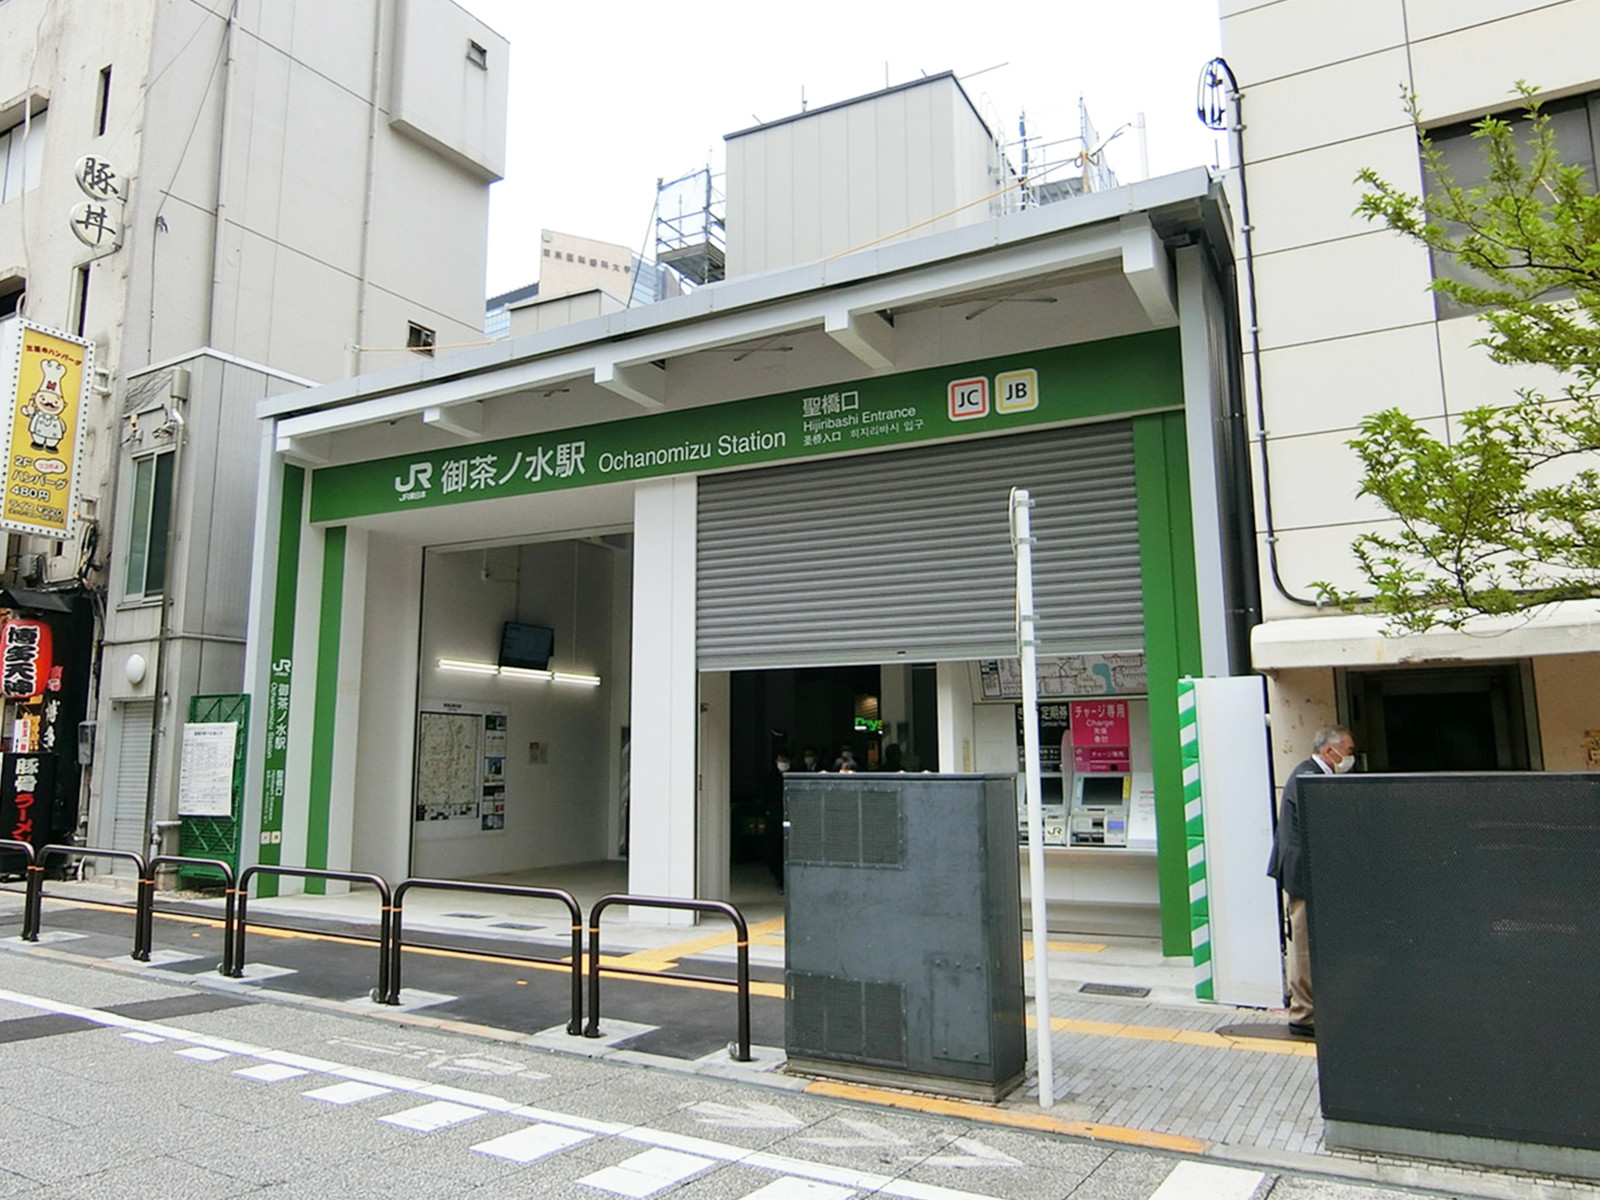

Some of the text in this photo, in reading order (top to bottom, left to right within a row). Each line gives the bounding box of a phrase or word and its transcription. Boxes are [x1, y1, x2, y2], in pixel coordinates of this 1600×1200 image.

[75, 157, 119, 244] 豚丼
[802, 391, 859, 417] 聖橋口
[958, 389, 979, 408] JC
[1006, 382, 1028, 401] JB
[803, 406, 916, 434] Hijiribashi Entrance
[903, 418, 924, 432] 입구
[598, 430, 786, 473] Ochanomizu Station
[12, 469, 68, 490] ハンバーグ
[395, 462, 433, 493] JR
[441, 441, 586, 495] 御茶ノ水駅
[10, 484, 50, 503] 480円
[273, 659, 292, 673] JR
[274, 683, 290, 750] 御茶ノ水駅
